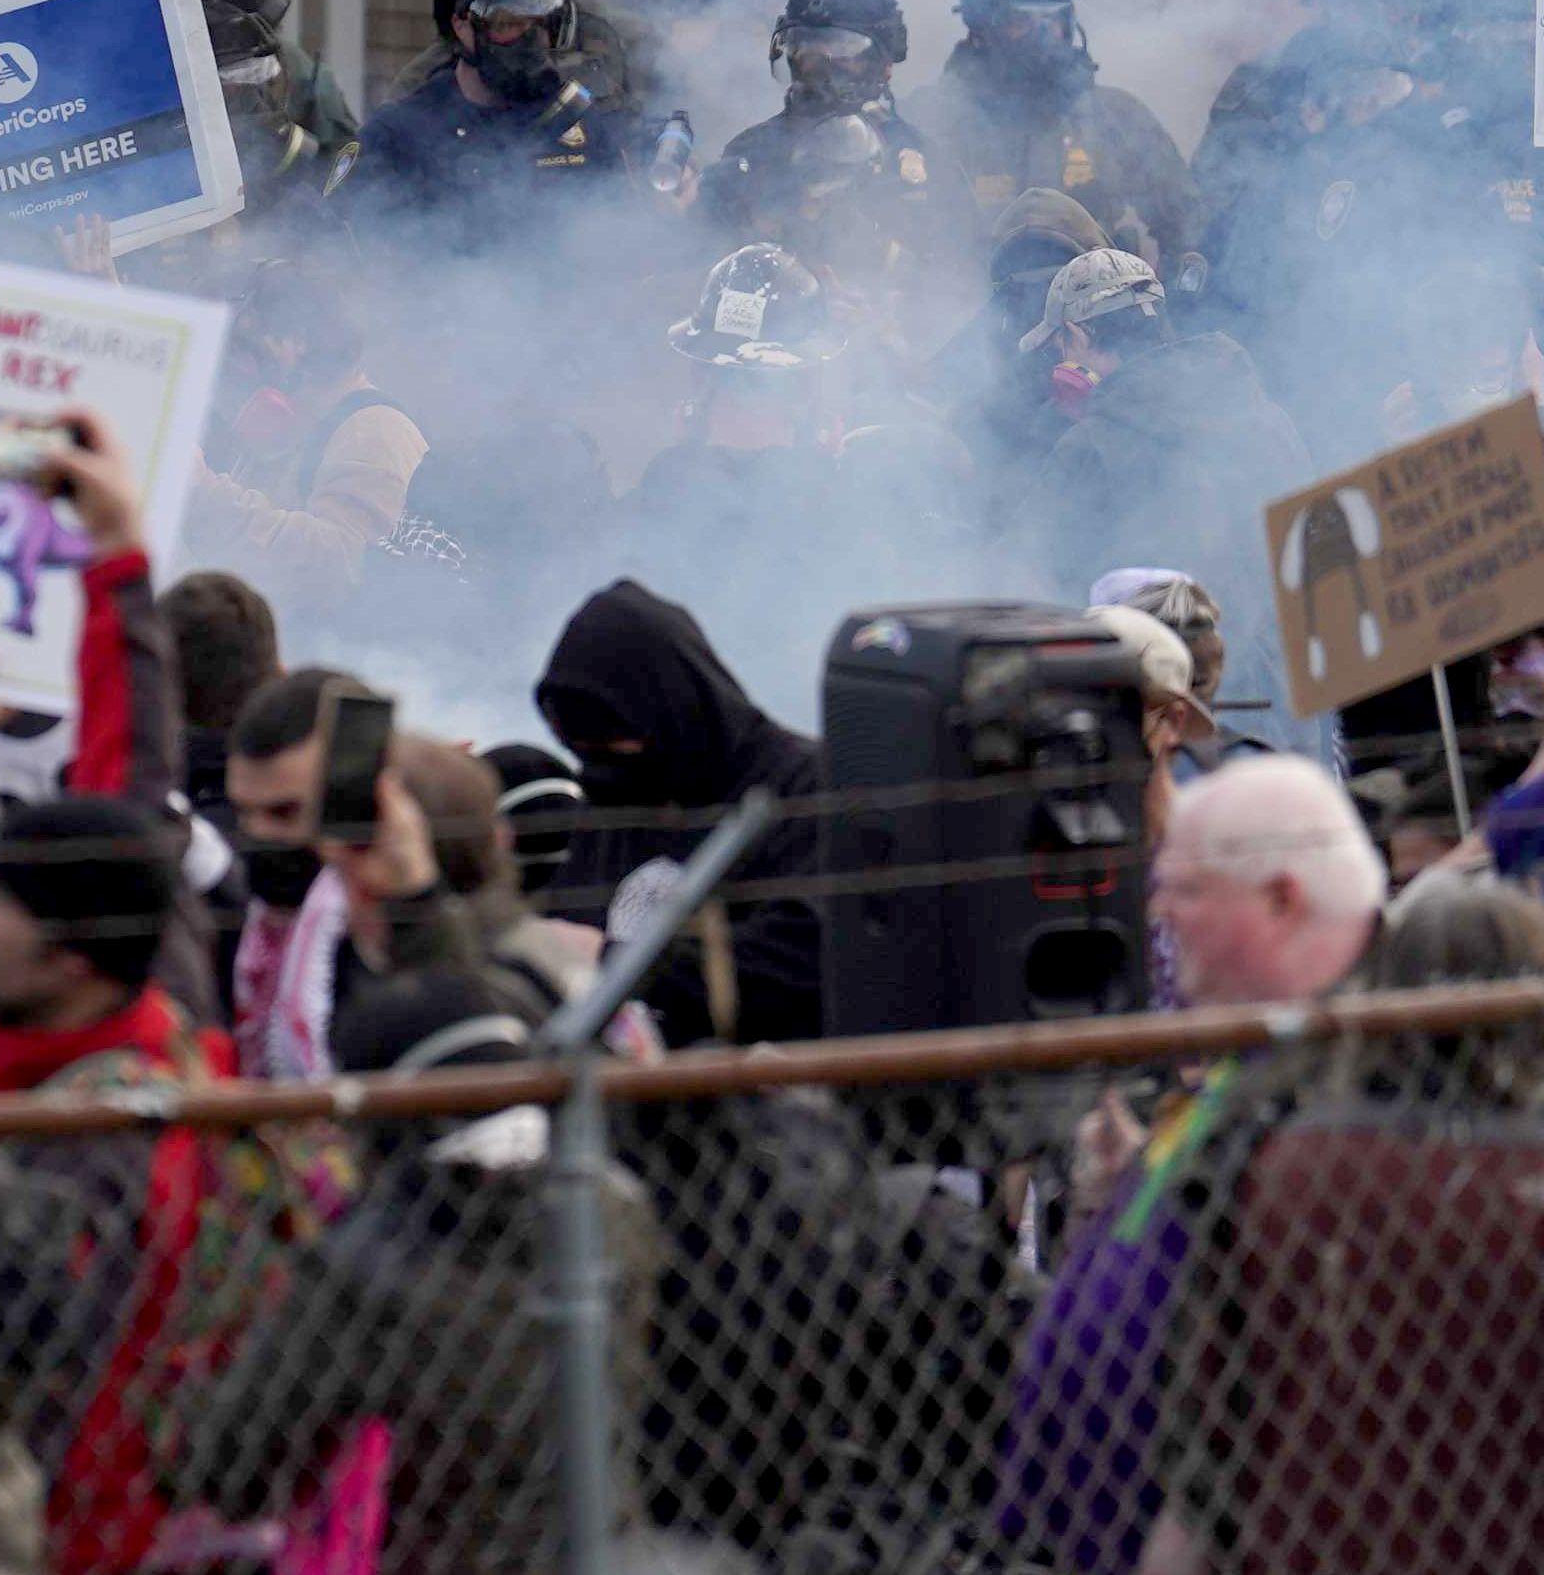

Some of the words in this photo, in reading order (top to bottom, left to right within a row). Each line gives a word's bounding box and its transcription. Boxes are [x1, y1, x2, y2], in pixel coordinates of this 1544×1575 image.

[60, 130, 139, 174] HERE
[8, 189, 90, 219] riCorps.gov
[2, 348, 81, 394] REX
